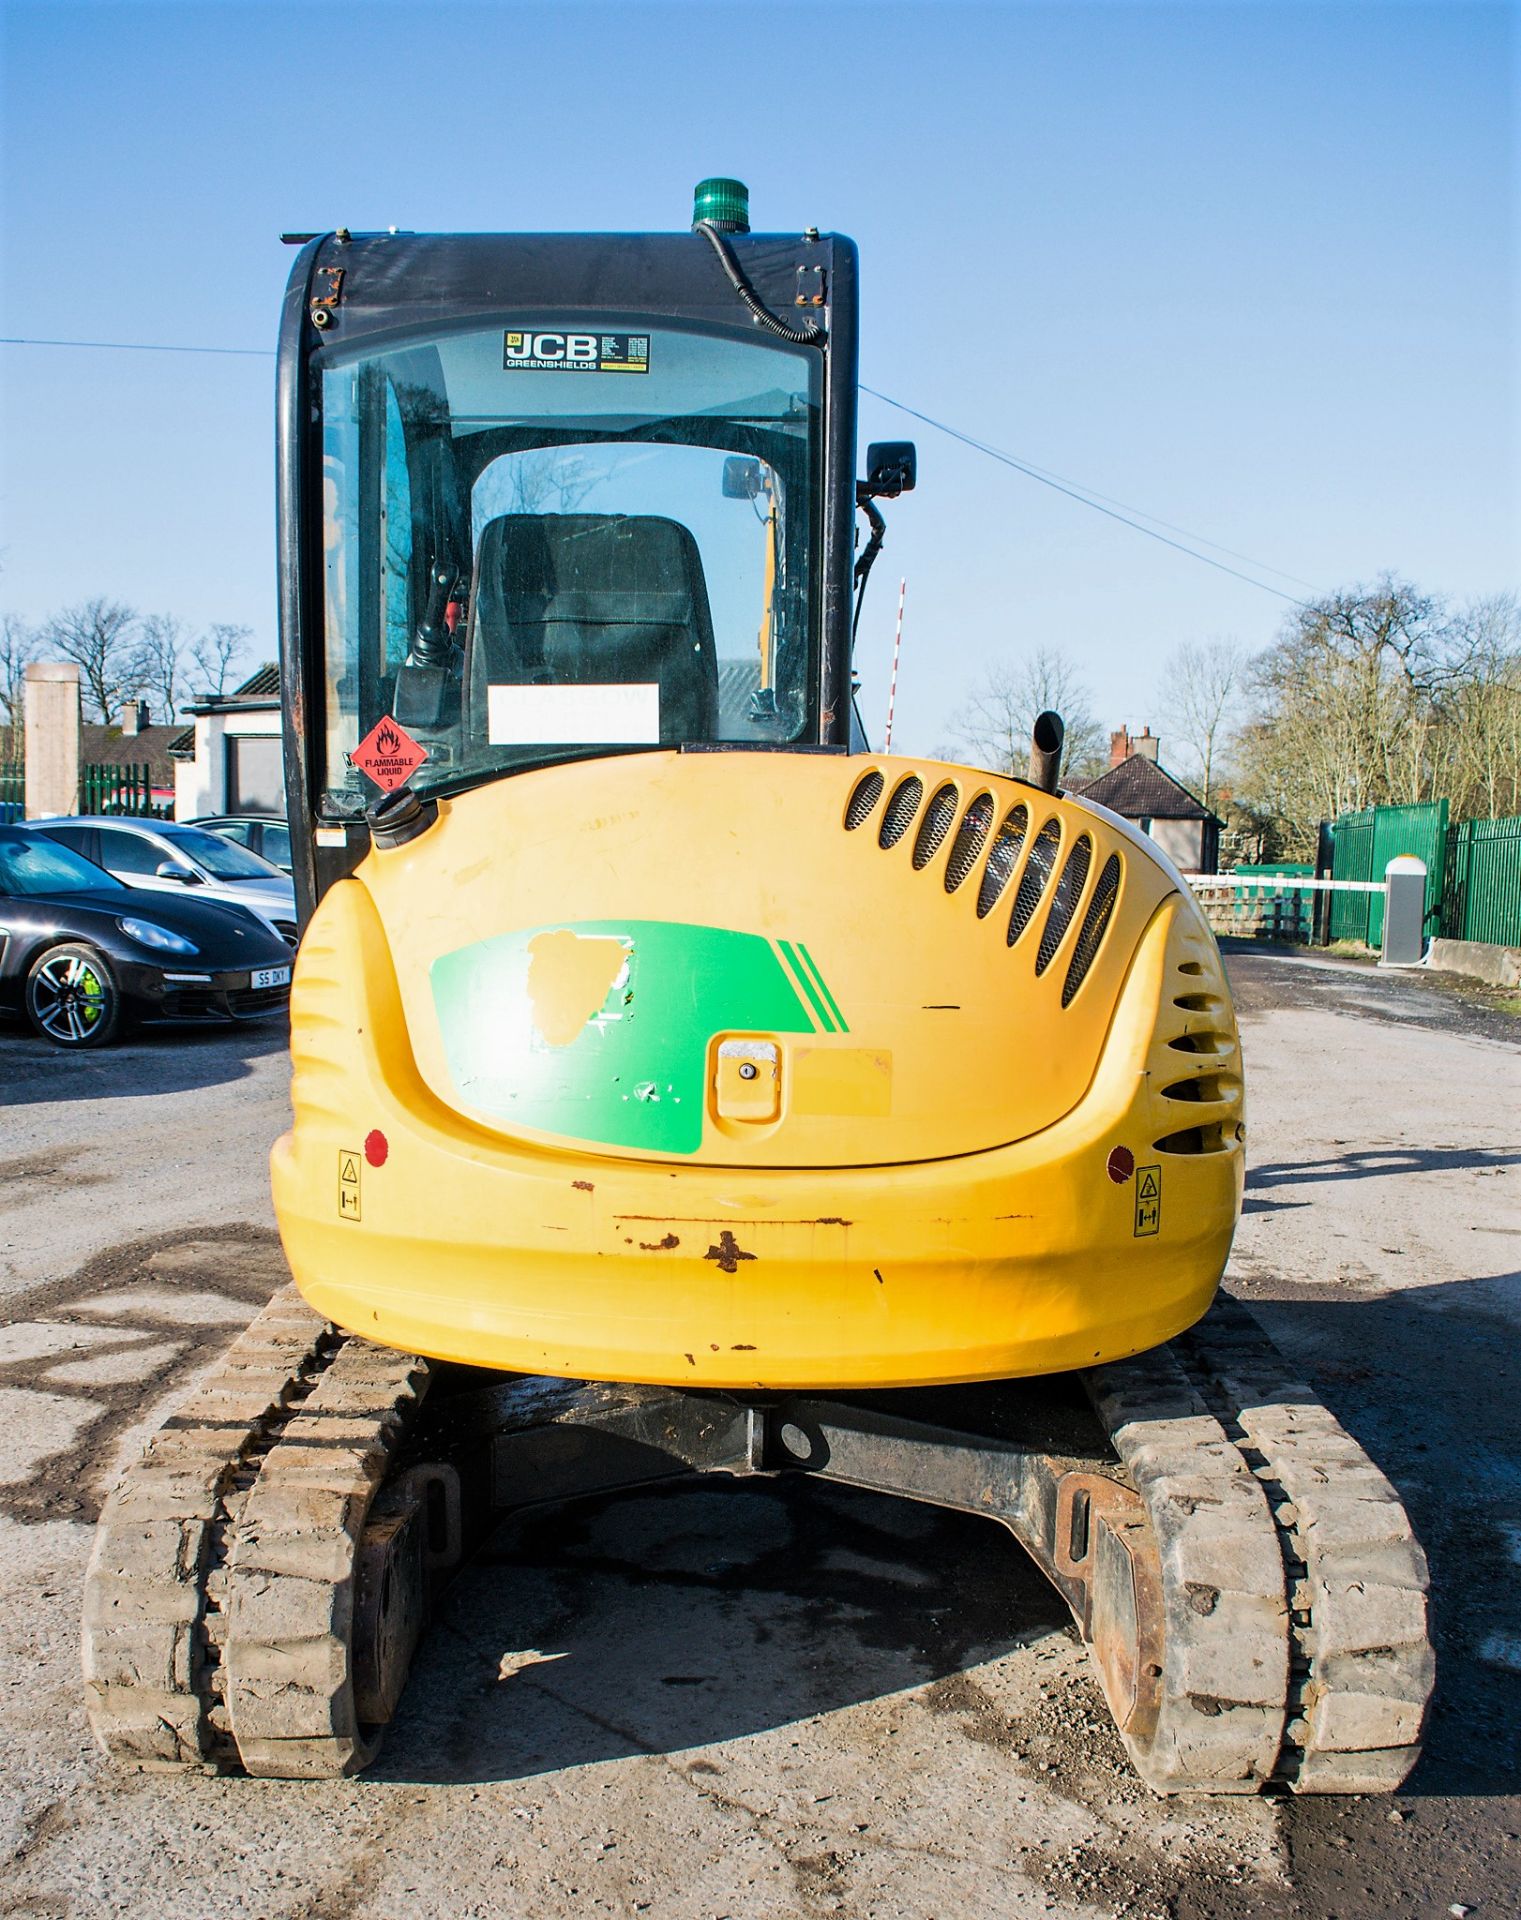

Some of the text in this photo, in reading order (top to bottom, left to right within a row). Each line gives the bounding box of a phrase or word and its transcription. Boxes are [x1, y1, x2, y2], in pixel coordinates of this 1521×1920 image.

[506, 333, 598, 361] JCB
[506, 359, 597, 369] GREENSHIELDS
[365, 758, 414, 767] FLAMMABLE
[377, 767, 402, 776] LIQUID
[387, 778, 393, 787] 3
